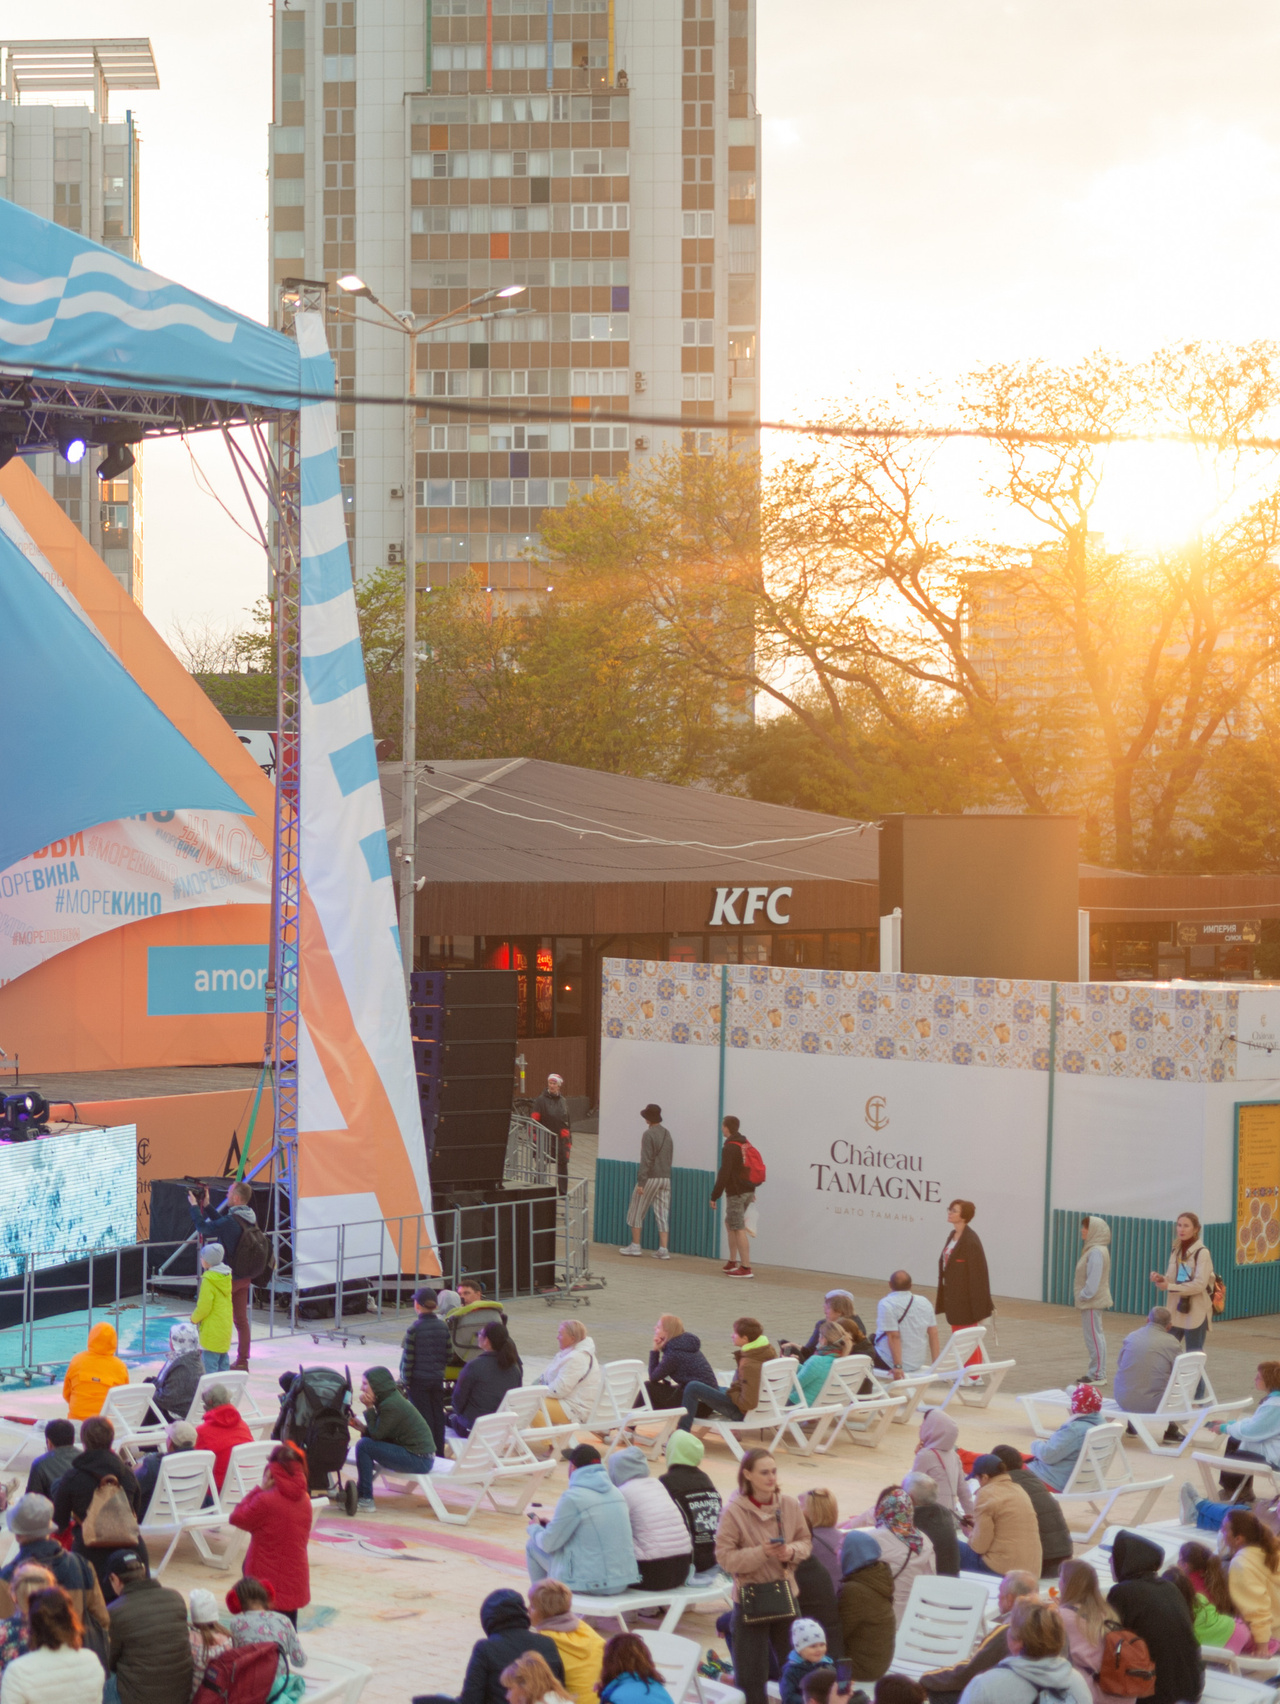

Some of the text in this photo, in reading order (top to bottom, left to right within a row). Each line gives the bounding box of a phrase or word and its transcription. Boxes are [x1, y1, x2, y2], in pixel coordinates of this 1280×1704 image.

[55, 888, 162, 916] #МОРЕКИНО
[709, 886, 793, 925] KFC
[1203, 924, 1237, 934] ИМПЕРИЯ
[830, 1139, 923, 1172] Château
[809, 1163, 942, 1203] TAMAGNE
[834, 1206, 915, 1222] ШАТО ТАМАНЬ
